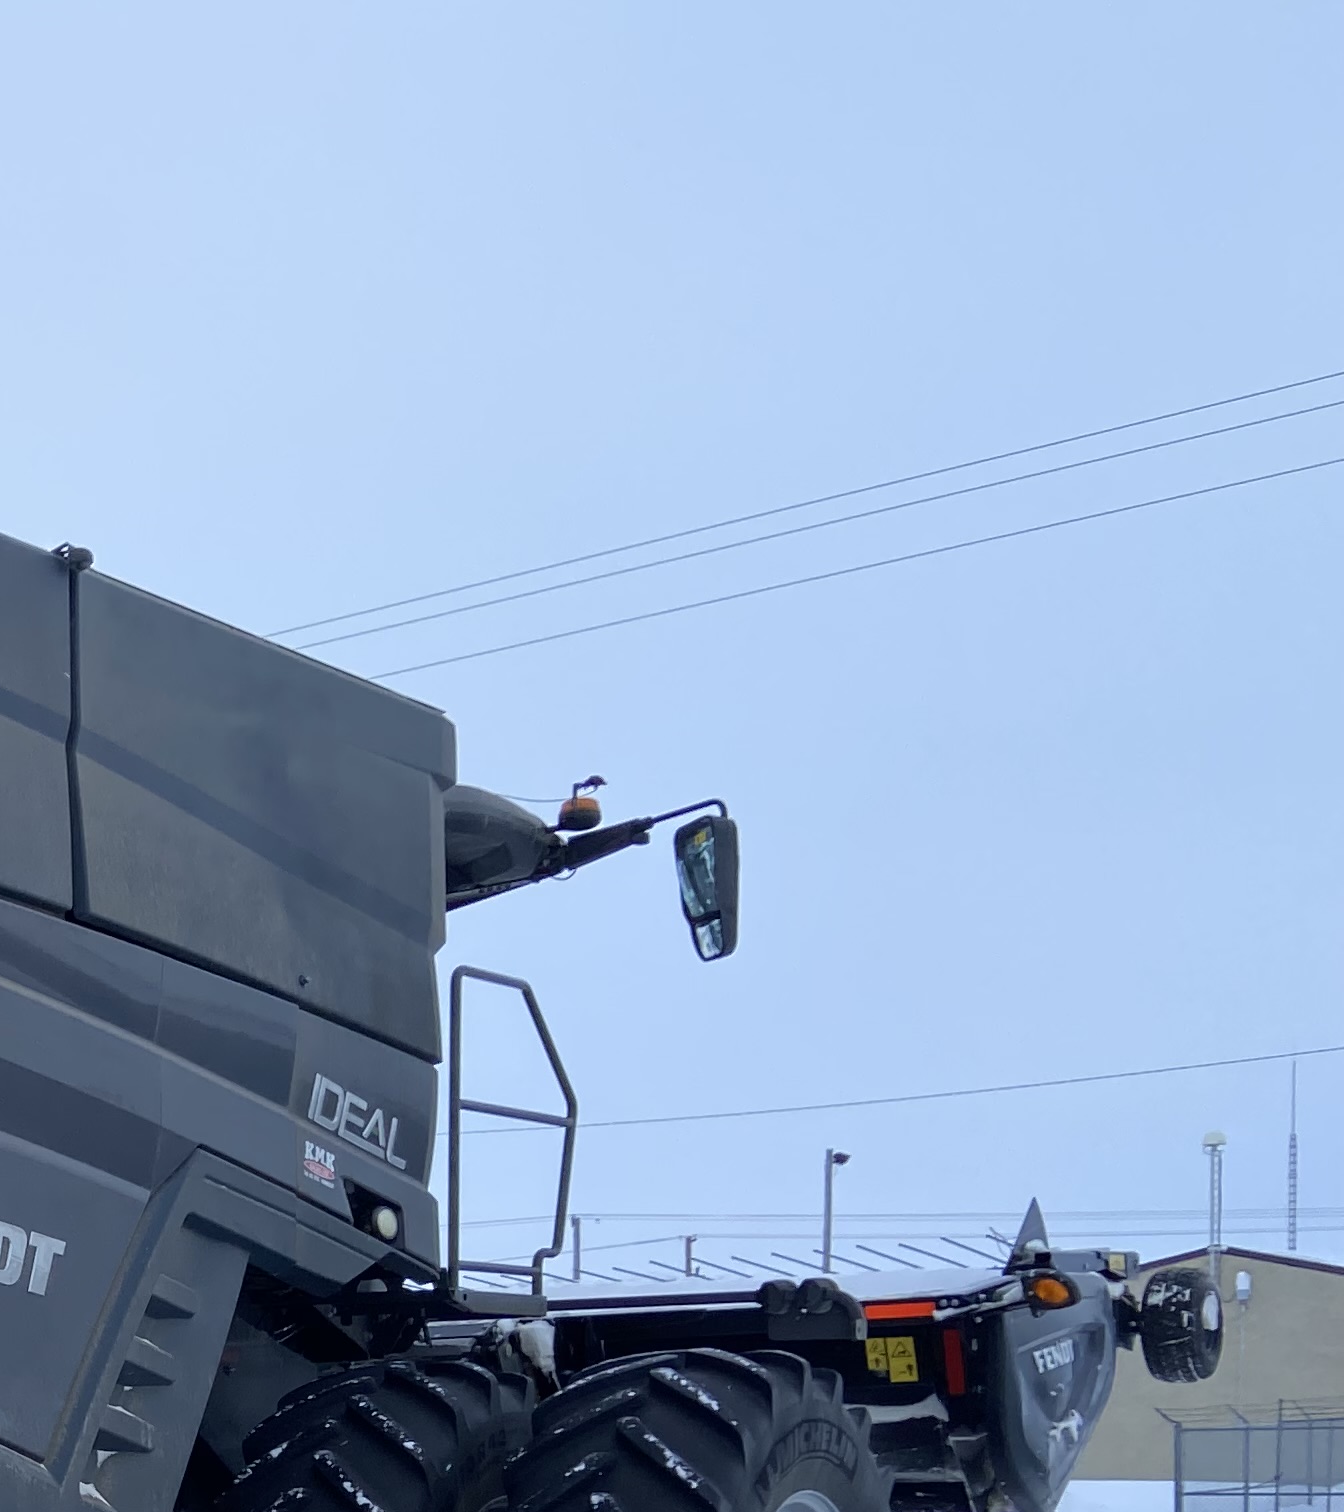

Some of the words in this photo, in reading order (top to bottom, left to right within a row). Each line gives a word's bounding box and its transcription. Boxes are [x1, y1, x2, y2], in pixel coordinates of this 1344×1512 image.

[308, 1072, 407, 1170] IDEAL
[304, 1140, 335, 1173] KMK
[1033, 1338, 1075, 1374] FENDT
